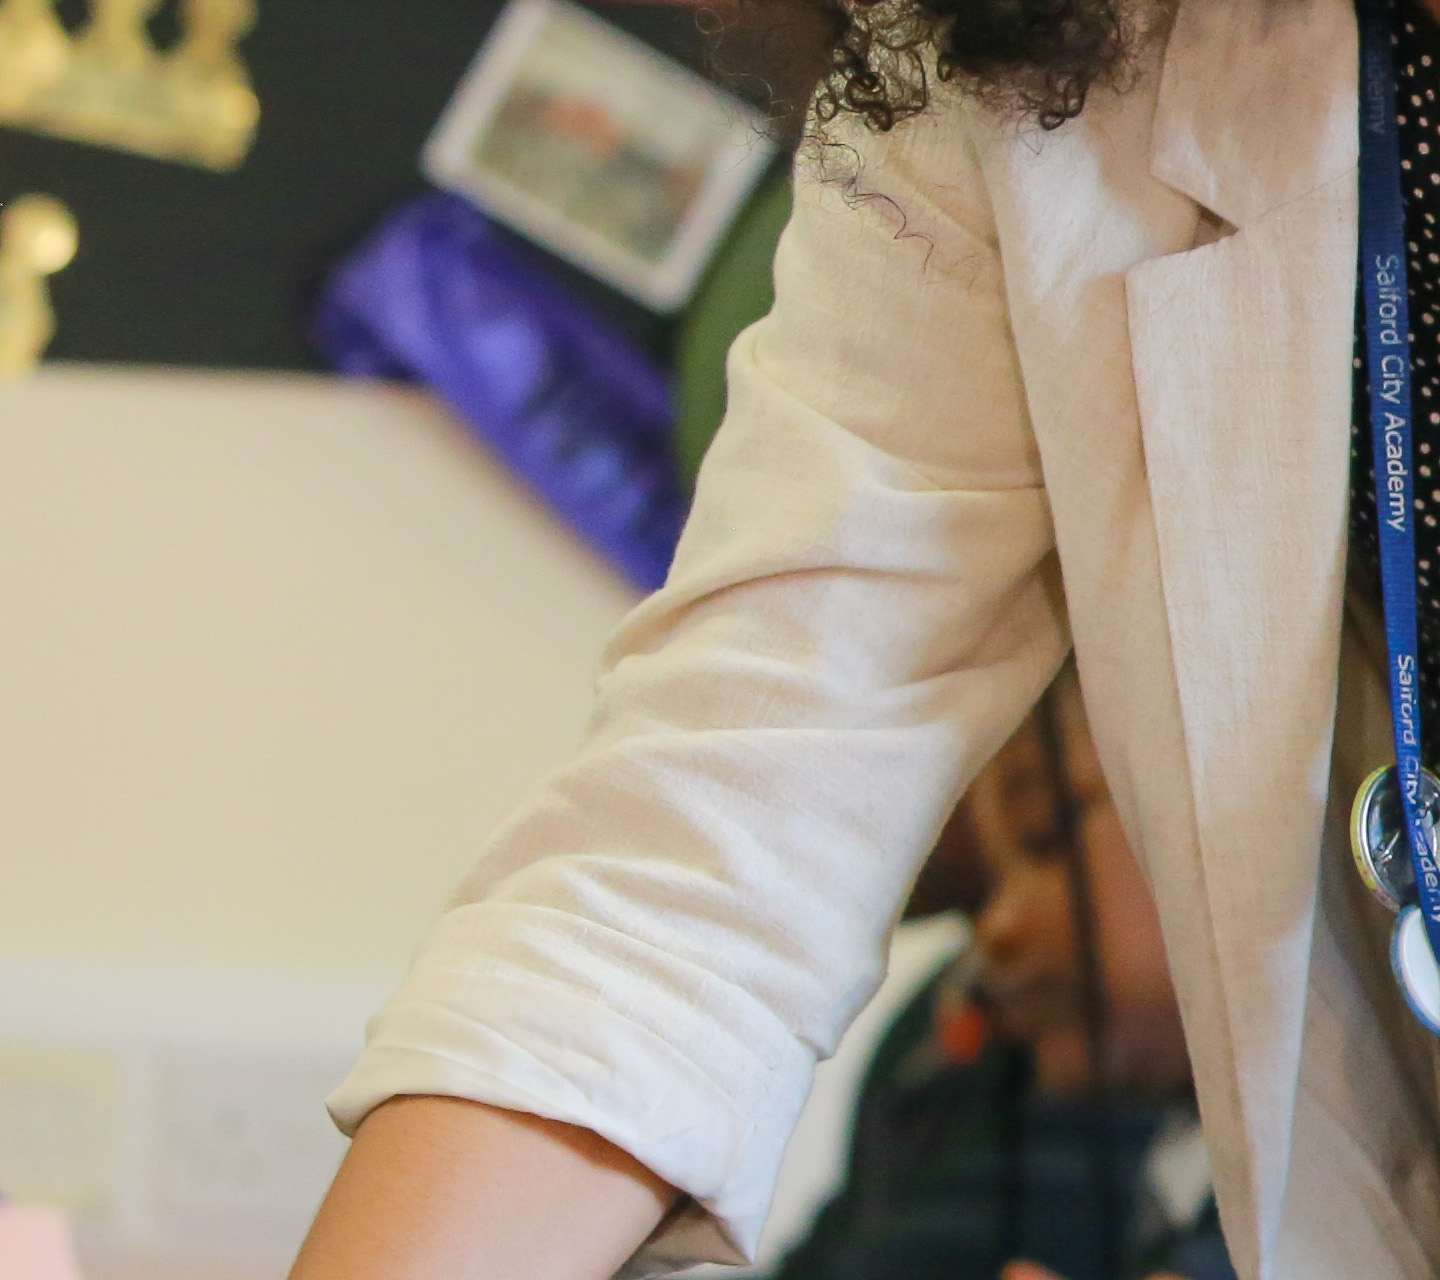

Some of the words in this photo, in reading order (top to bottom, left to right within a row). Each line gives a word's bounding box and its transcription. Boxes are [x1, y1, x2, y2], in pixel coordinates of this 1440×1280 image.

[1375, 253, 1402, 347] Salford
[1380, 354, 1405, 405] City
[1384, 412, 1406, 532] Academy
[1397, 654, 1417, 746] Salford
